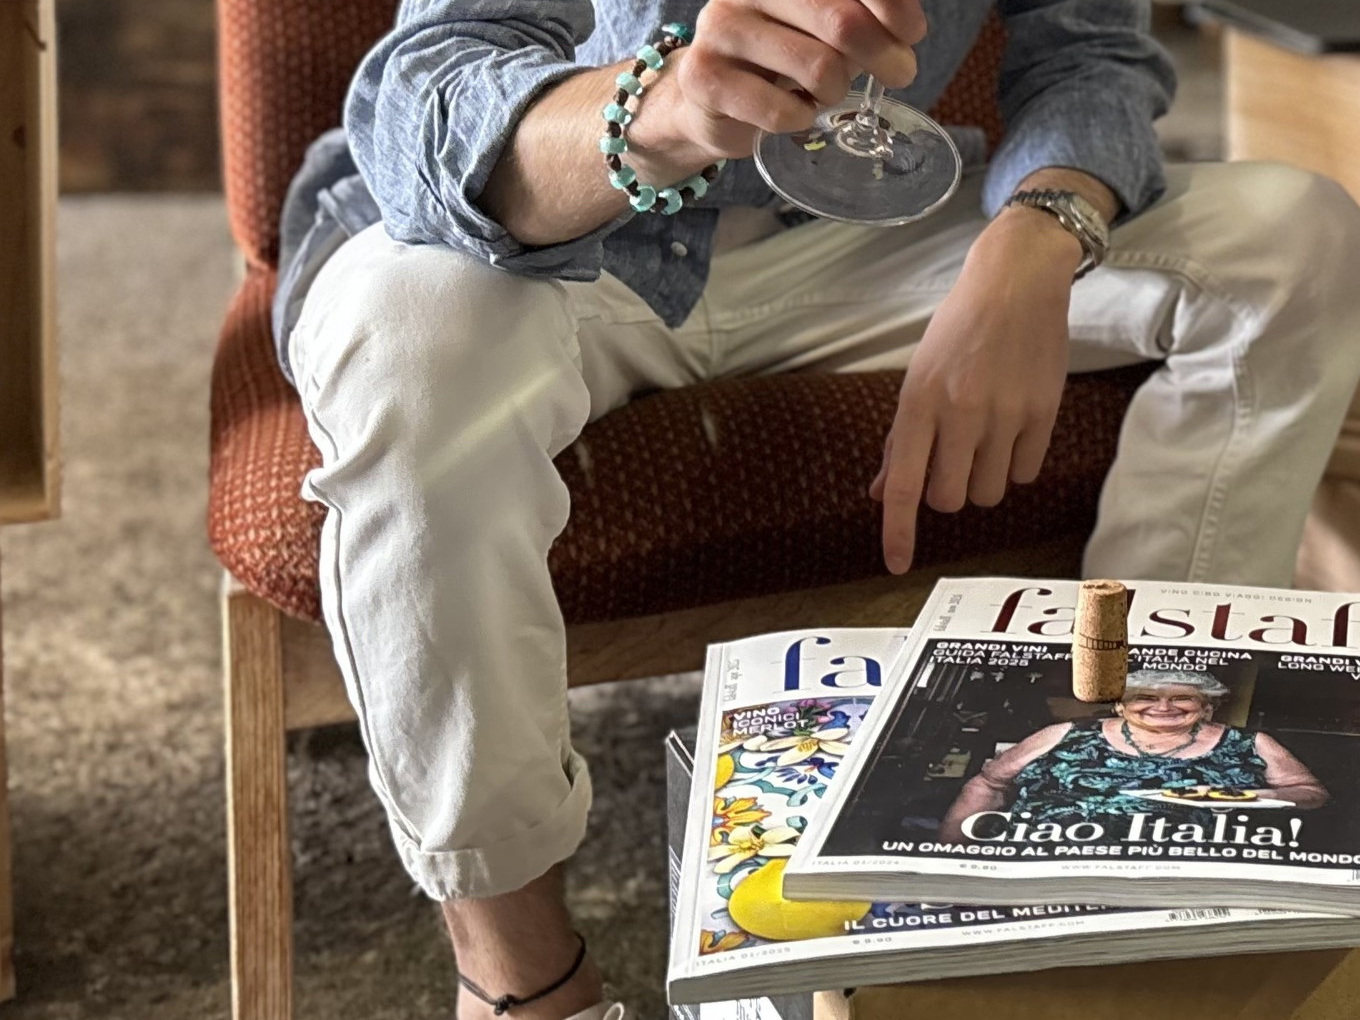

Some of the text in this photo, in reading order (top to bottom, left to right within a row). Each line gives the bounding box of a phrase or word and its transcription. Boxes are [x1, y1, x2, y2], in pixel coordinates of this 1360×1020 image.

[933, 648, 985, 658] GUIDA
[936, 641, 1048, 653] GRANDI VINI
[1128, 647, 1252, 660] ANDE CUCINA
[1280, 654, 1350, 665] GRANDI
[929, 655, 1029, 667] ITALIA 2025
[1142, 662, 1207, 672] MONDO
[1195, 657, 1229, 666] NEL
[1277, 661, 1325, 671] LONG
[732, 706, 780, 721] VINO
[733, 711, 800, 729] ICONICI
[732, 719, 809, 737] MERLOT
[960, 811, 1302, 848] Ciao Italia!
[882, 841, 914, 852] UN
[918, 842, 1018, 856] OMAGGIO
[1020, 846, 1049, 857] AL
[1054, 845, 1122, 857] PAESE
[1127, 843, 1163, 857] PIÙ
[1168, 846, 1237, 858] BELLO
[1242, 848, 1284, 861] DEL
[844, 919, 866, 931] IL
[872, 914, 953, 929] CUORE
[960, 910, 1005, 922] DEL
